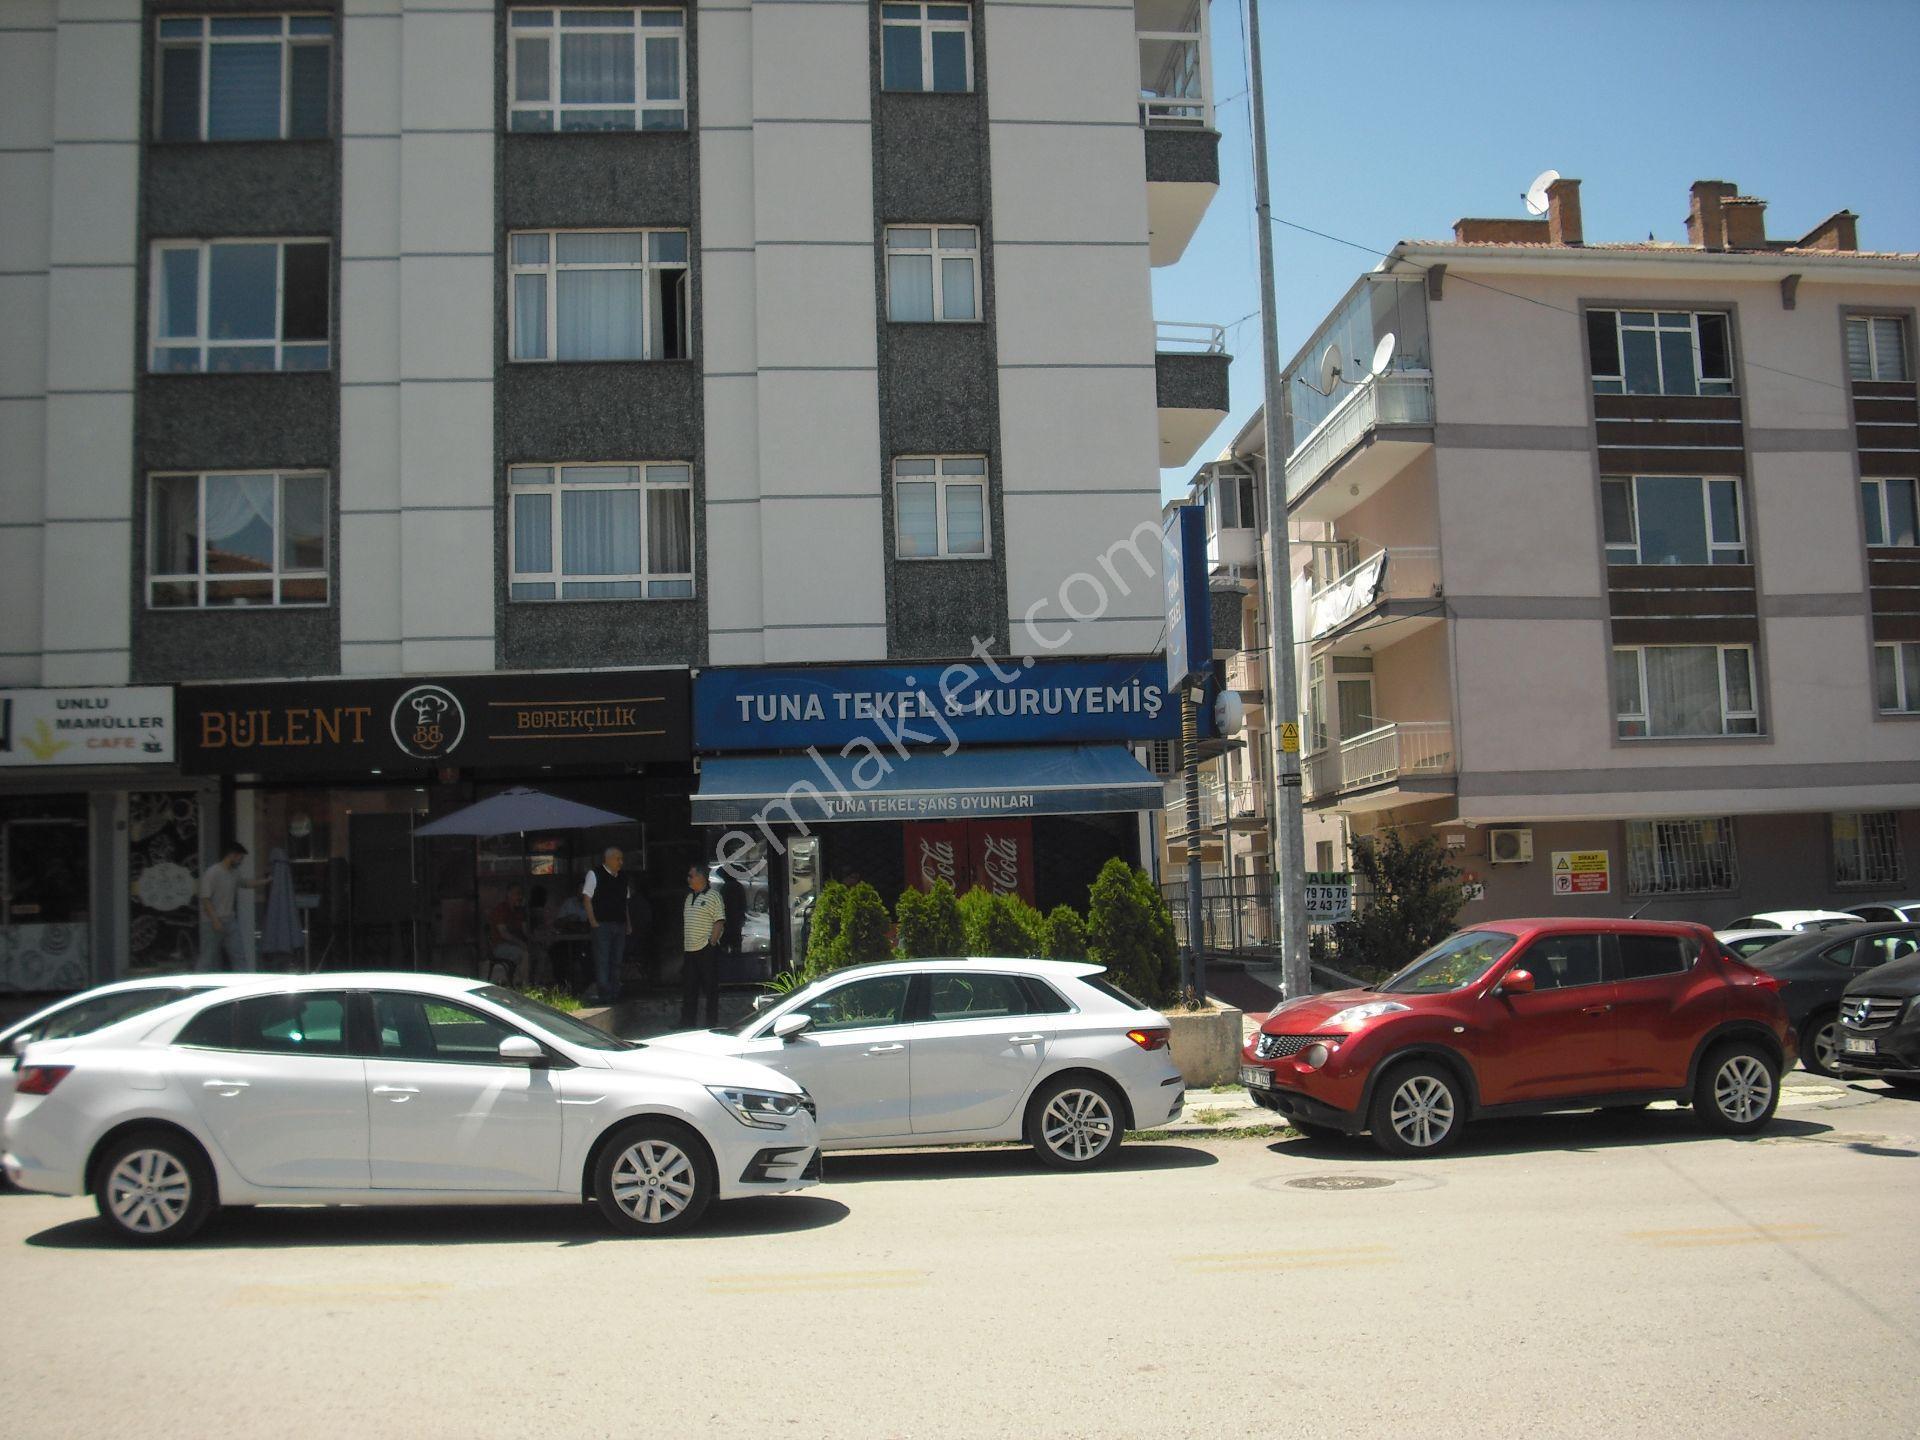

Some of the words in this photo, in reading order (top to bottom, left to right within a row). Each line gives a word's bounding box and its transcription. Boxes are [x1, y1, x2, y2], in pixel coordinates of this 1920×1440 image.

[736, 694, 825, 722] TUNA
[833, 691, 935, 720] TEKEL
[945, 694, 963, 716] &
[975, 678, 1163, 719] KURUYEMİŞ
[200, 707, 372, 748] BÜLENT
[517, 706, 637, 732] BÖREKÇİLİK
[827, 799, 866, 814] TUNA
[871, 799, 915, 812] TEKEL
[918, 797, 957, 813] ŞANS
[961, 795, 1034, 810] OYUNLARI
[1308, 873, 1347, 885] ALIK
[1320, 887, 1333, 899] 76
[1335, 887, 1348, 899] 76
[1320, 900, 1333, 911] 43
